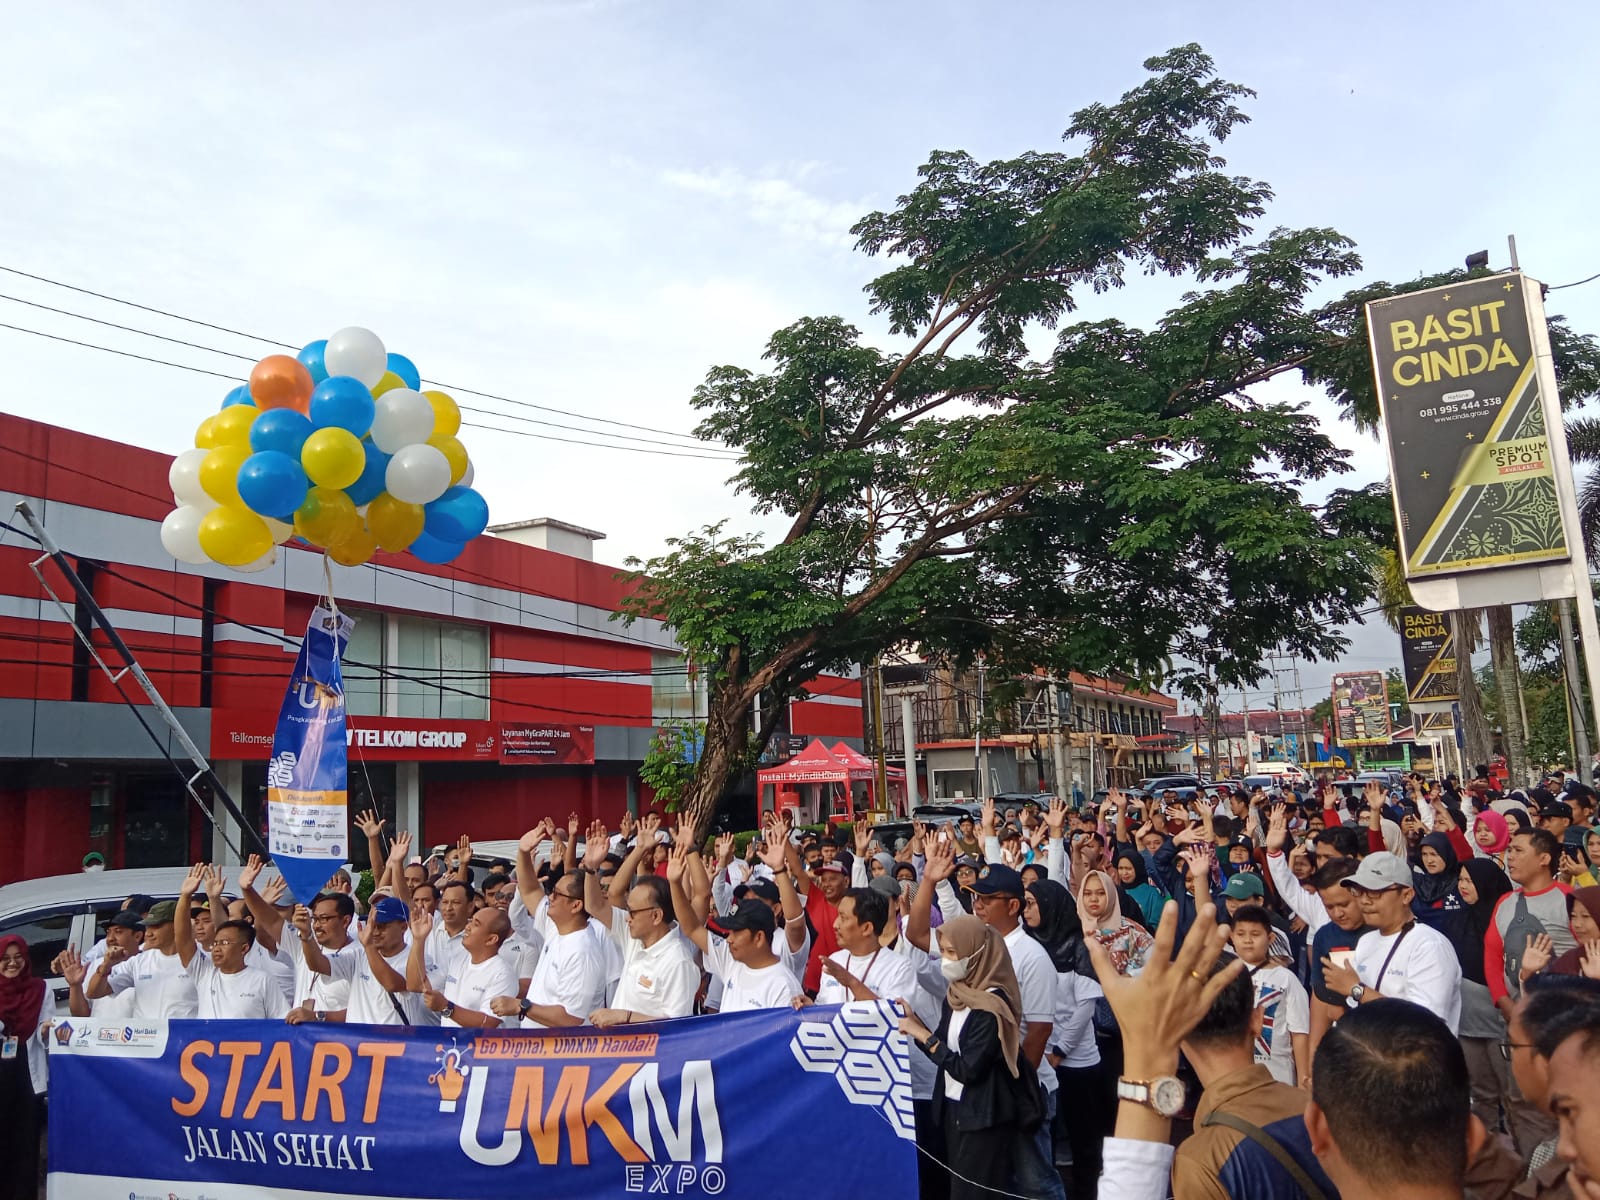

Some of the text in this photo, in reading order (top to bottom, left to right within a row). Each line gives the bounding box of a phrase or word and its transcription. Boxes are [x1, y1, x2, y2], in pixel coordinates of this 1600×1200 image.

[1390, 300, 1505, 352] BASIT
[1392, 338, 1520, 387] CINDA
[1420, 396, 1502, 417] 081 995 444 338
[1489, 441, 1548, 458] PREMIUM
[1496, 450, 1543, 467] SPOT
[1405, 612, 1443, 627] BASIT
[1405, 625, 1448, 639] CINDA
[230, 731, 274, 745] Telkomsel
[354, 729, 417, 748] TELKOM
[418, 730, 467, 748] GROUP
[759, 772, 786, 782] Install
[1238, 834, 1245, 843] 7
[480, 1035, 657, 1058] Go Digital, UMKM Handal!
[171, 1039, 406, 1124] START
[459, 1059, 724, 1166] UMKM
[181, 1125, 376, 1172] JALAN SEHAT
[624, 1164, 726, 1195] EXPO
